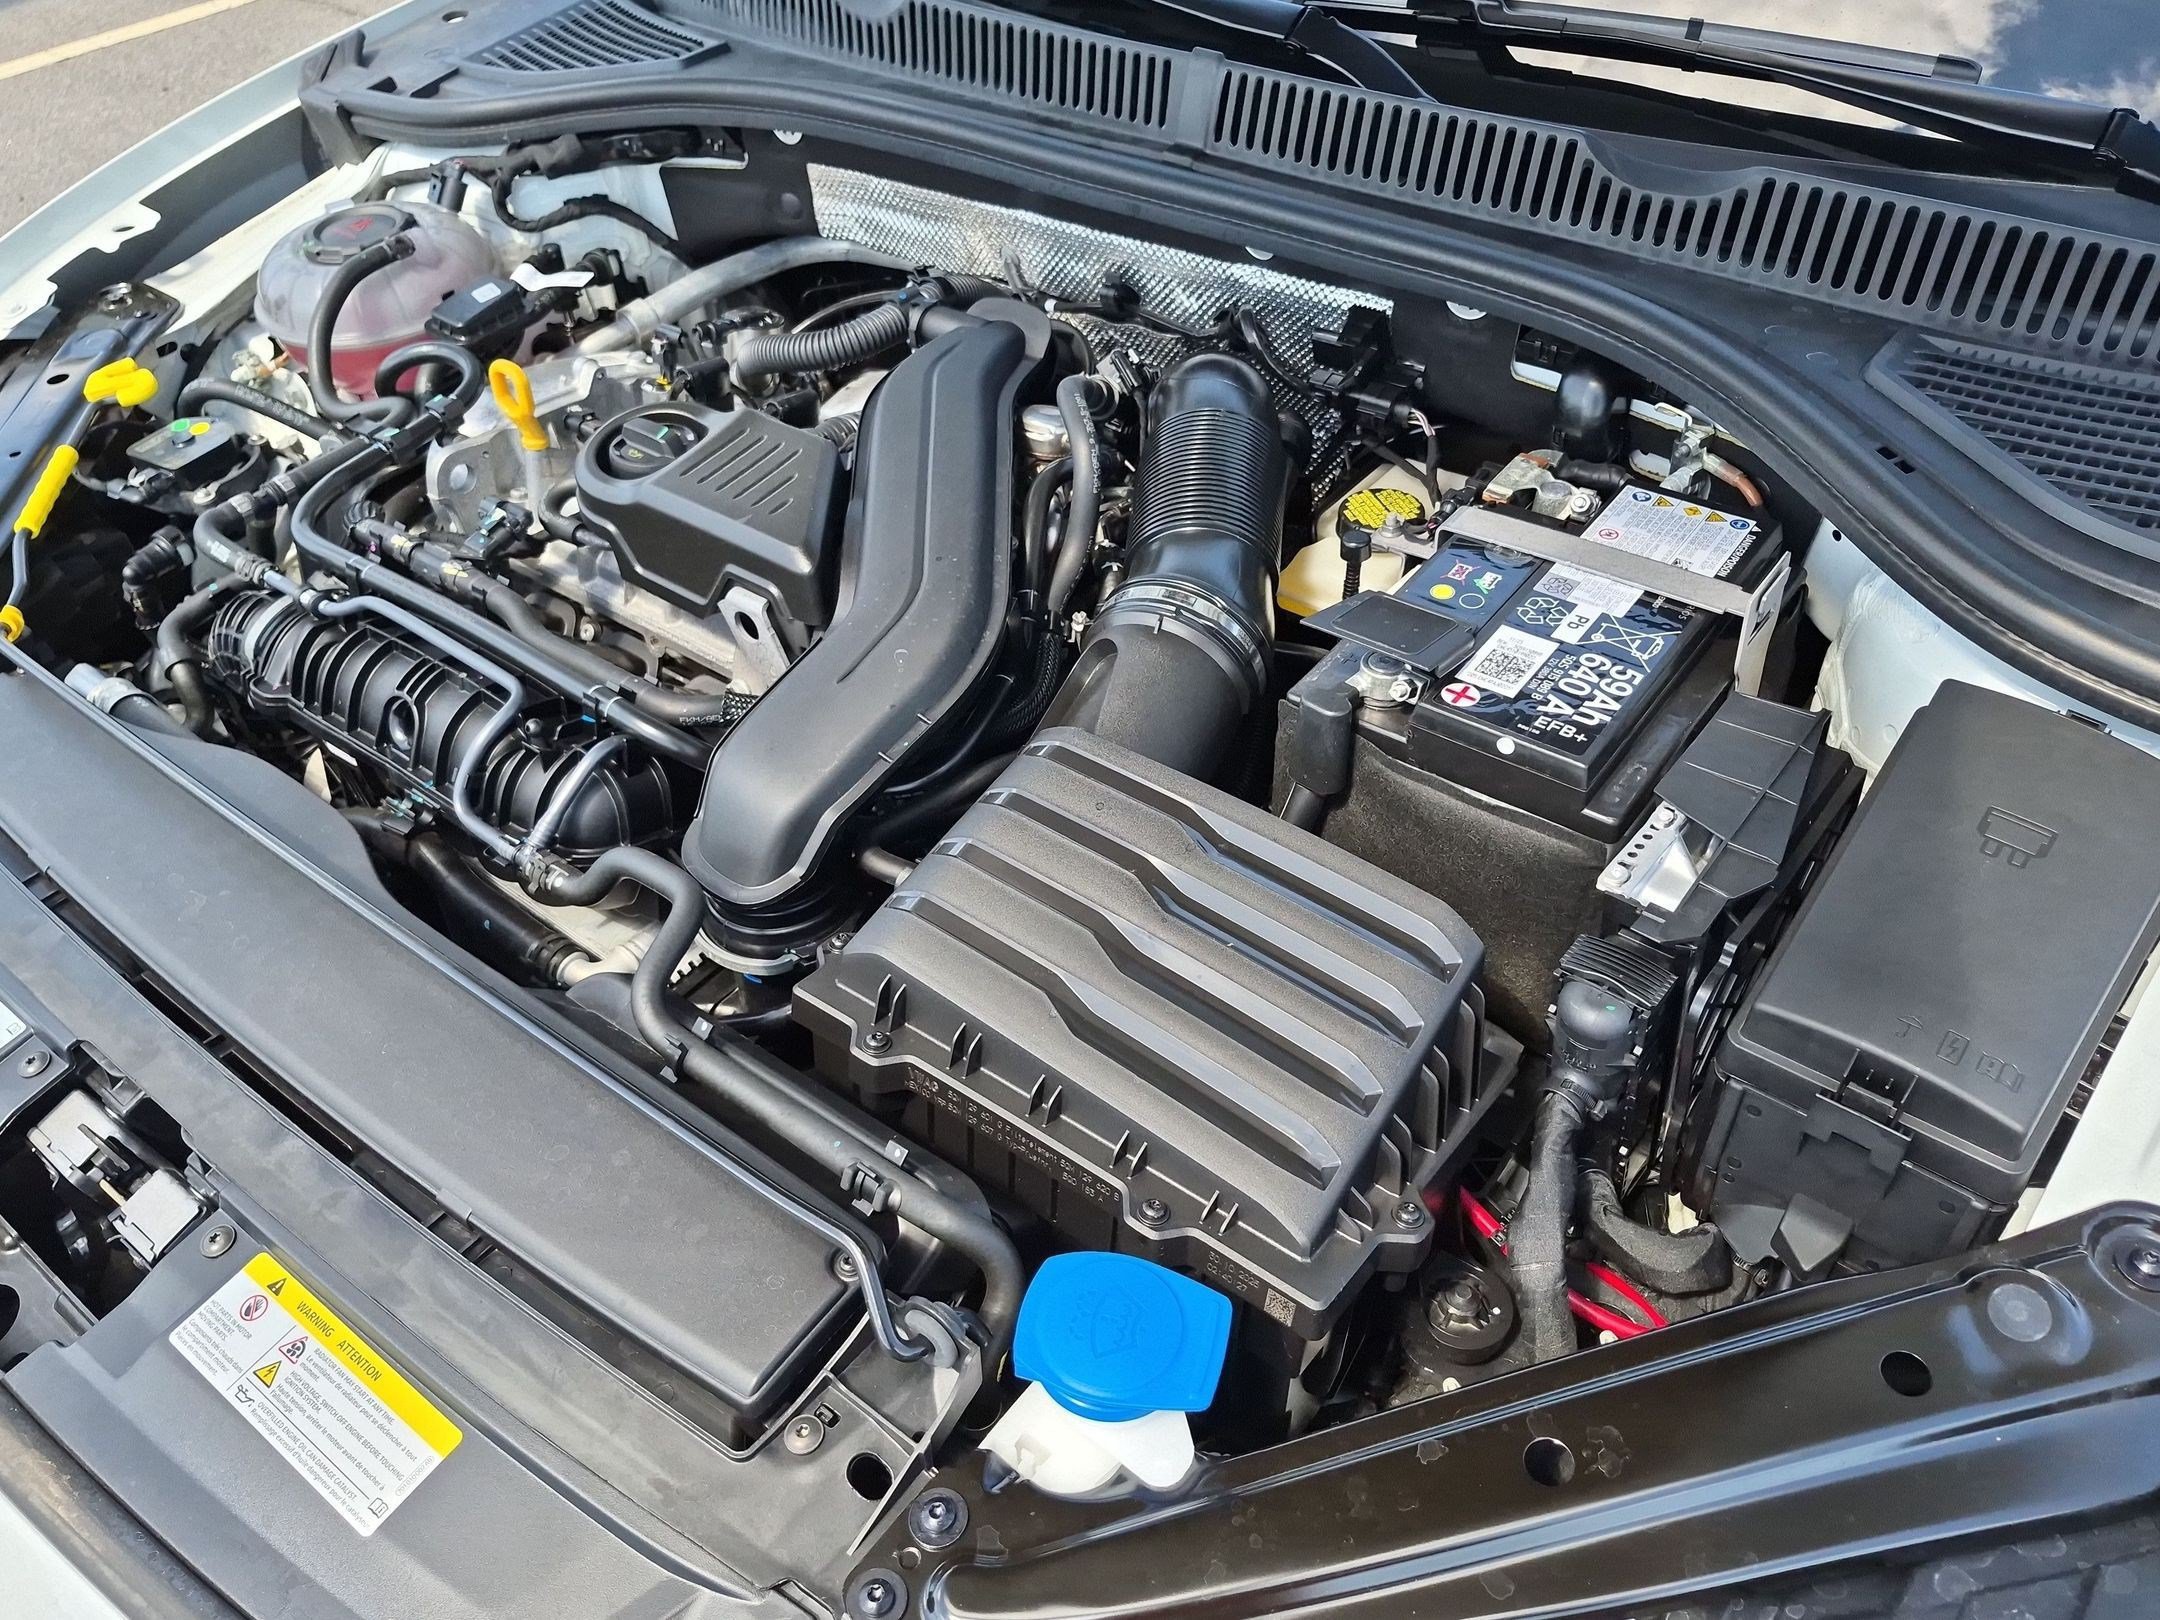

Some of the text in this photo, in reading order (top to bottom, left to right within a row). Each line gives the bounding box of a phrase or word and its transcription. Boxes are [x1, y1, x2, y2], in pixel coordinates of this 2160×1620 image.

[1567, 614, 1590, 629] Pb
[1528, 678, 1541, 690] DIN
[1531, 654, 1577, 701] 5QS 915 089 B
[1536, 693, 1576, 716] A
[1558, 653, 1612, 696] 640
[1572, 665, 1644, 726] 59Ah
[1534, 715, 1587, 742] EFB+
[295, 1300, 383, 1381] WARNING ATTENTION
[283, 1376, 305, 1397] IGNITION
[305, 1354, 314, 1363] Le
[310, 1360, 337, 1385] ventilateur
[333, 1381, 343, 1391] de
[340, 1387, 363, 1409] radiateur
[359, 1406, 373, 1420] peut
[370, 1417, 379, 1425] se
[404, 1448, 418, 1461] tout
[313, 1347, 396, 1425] RADIATOR FAN MAY START AT ANY TIME.
[248, 1407, 278, 1438] Remplissage
[304, 1464, 332, 1492] dangereux
[328, 1488, 342, 1502] pour
[256, 1401, 285, 1429] OVERFILLED
[281, 1426, 300, 1445] ENGINE
[297, 1441, 308, 1452] OIL
[304, 1449, 317, 1462] CAN
[313, 1458, 336, 1480] DAMAGE
[275, 1383, 292, 1399] Haute
[320, 1427, 328, 1435] le
[325, 1431, 345, 1451] moteur
[341, 1447, 358, 1464] avant
[354, 1460, 364, 1470] de
[361, 1466, 382, 1487] toucher
[289, 1370, 303, 1383] HIGH
[319, 1398, 339, 1417] SWITCH
[335, 1414, 348, 1426] OFF
[344, 1422, 364, 1442] ENGINE
[361, 1438, 381, 1458] BEFORE
[378, 1455, 405, 1481] TOUCHING
